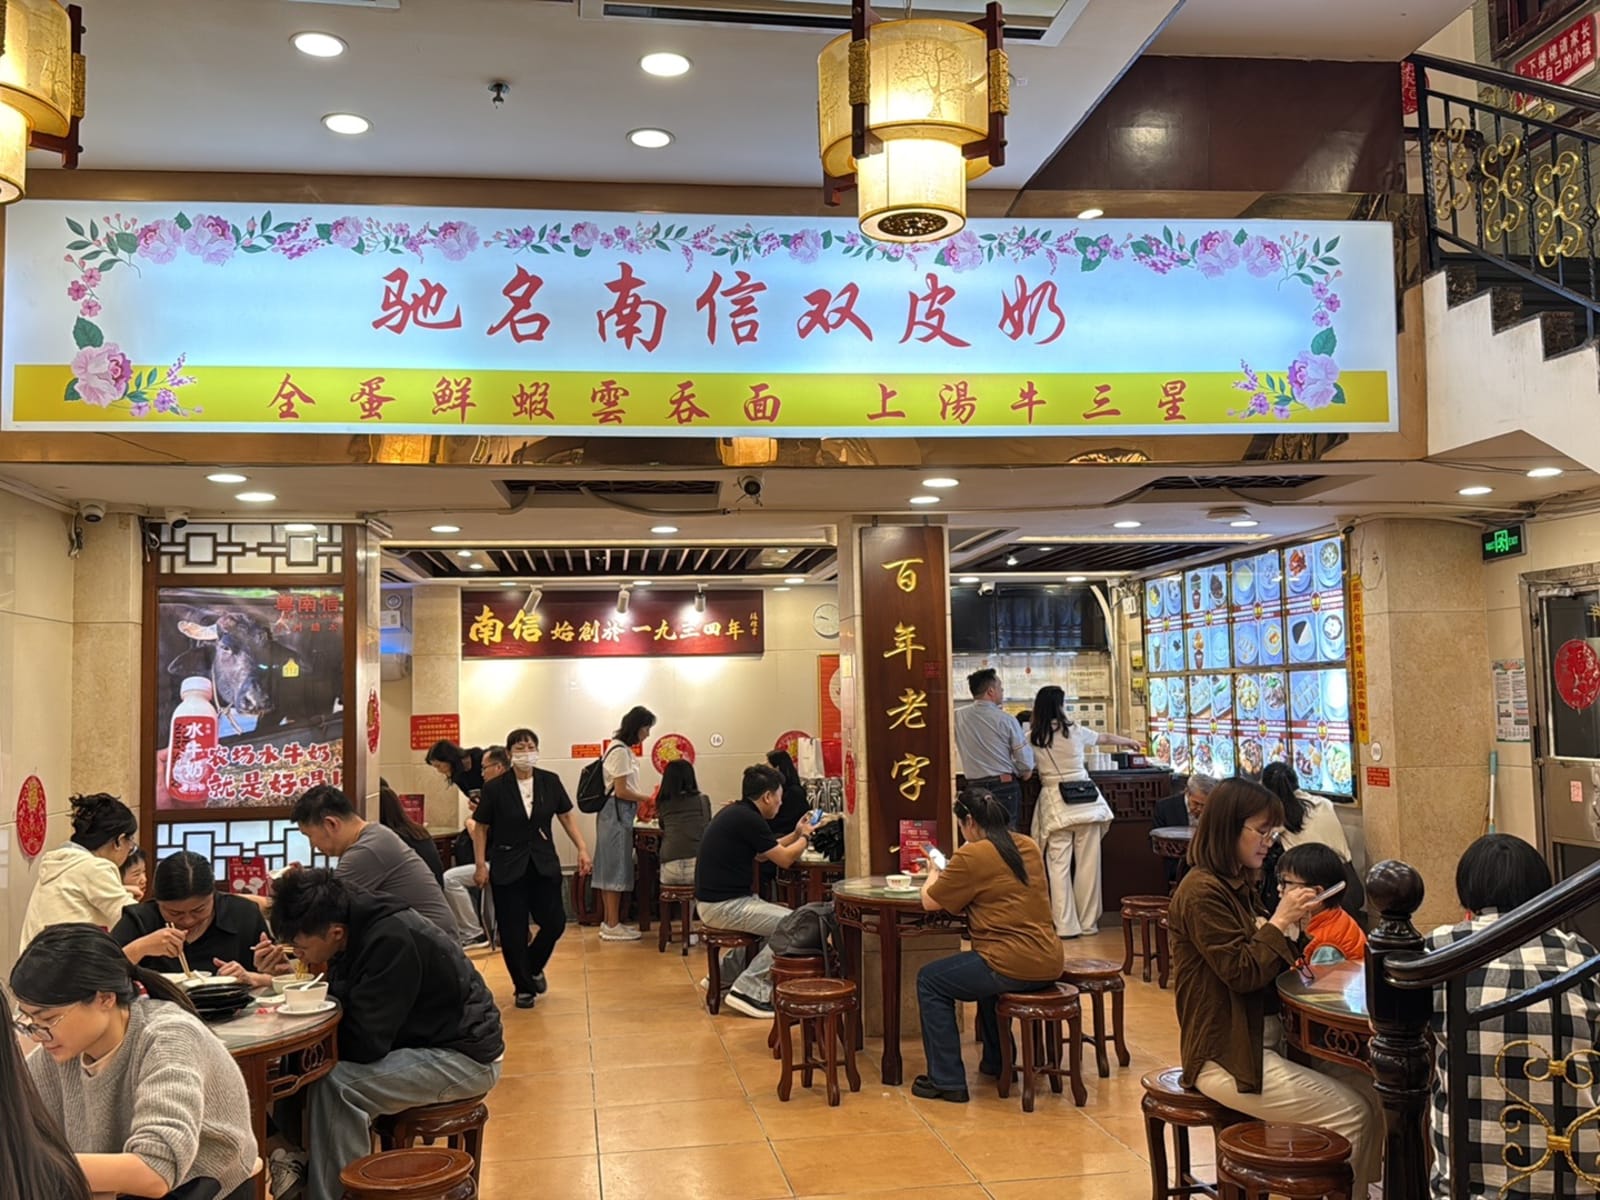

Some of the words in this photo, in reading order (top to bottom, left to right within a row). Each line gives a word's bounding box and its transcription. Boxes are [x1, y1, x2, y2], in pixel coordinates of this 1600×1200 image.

[372, 262, 1066, 353] 驰名南信双皮奶
[267, 372, 781, 425] 全蛋鮮蝦雲吞面
[866, 380, 1188, 424] 上湯牛三星
[469, 605, 543, 646] 南信
[880, 556, 932, 853] 百年老字
